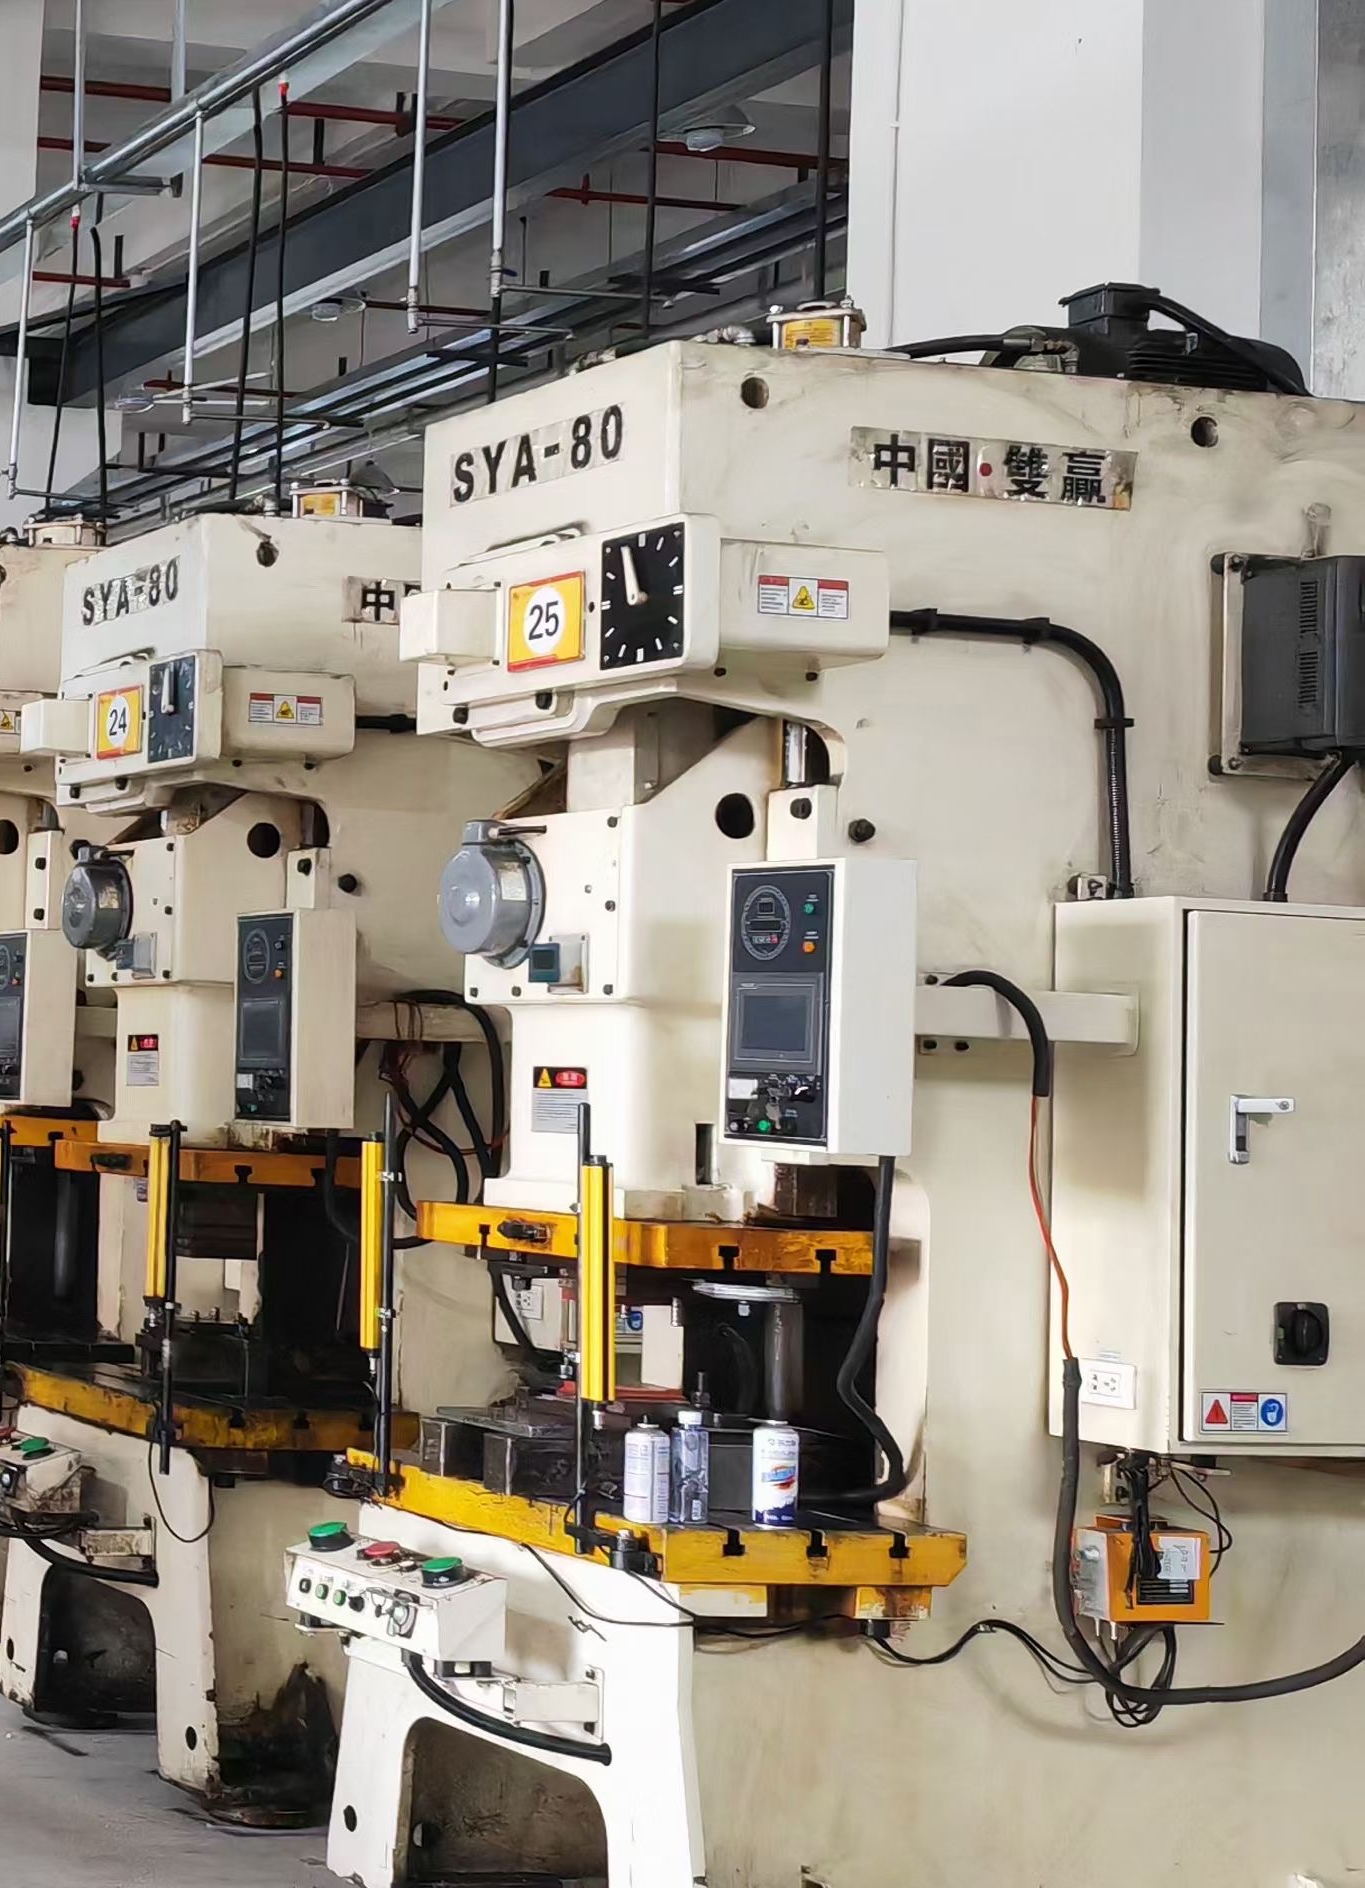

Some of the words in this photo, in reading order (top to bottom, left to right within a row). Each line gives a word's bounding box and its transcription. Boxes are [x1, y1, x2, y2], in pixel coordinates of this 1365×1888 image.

[453, 404, 623, 503] SYA-80
[82, 559, 178, 626] SYA-80
[528, 600, 559, 641] 25
[109, 706, 127, 736] 24
